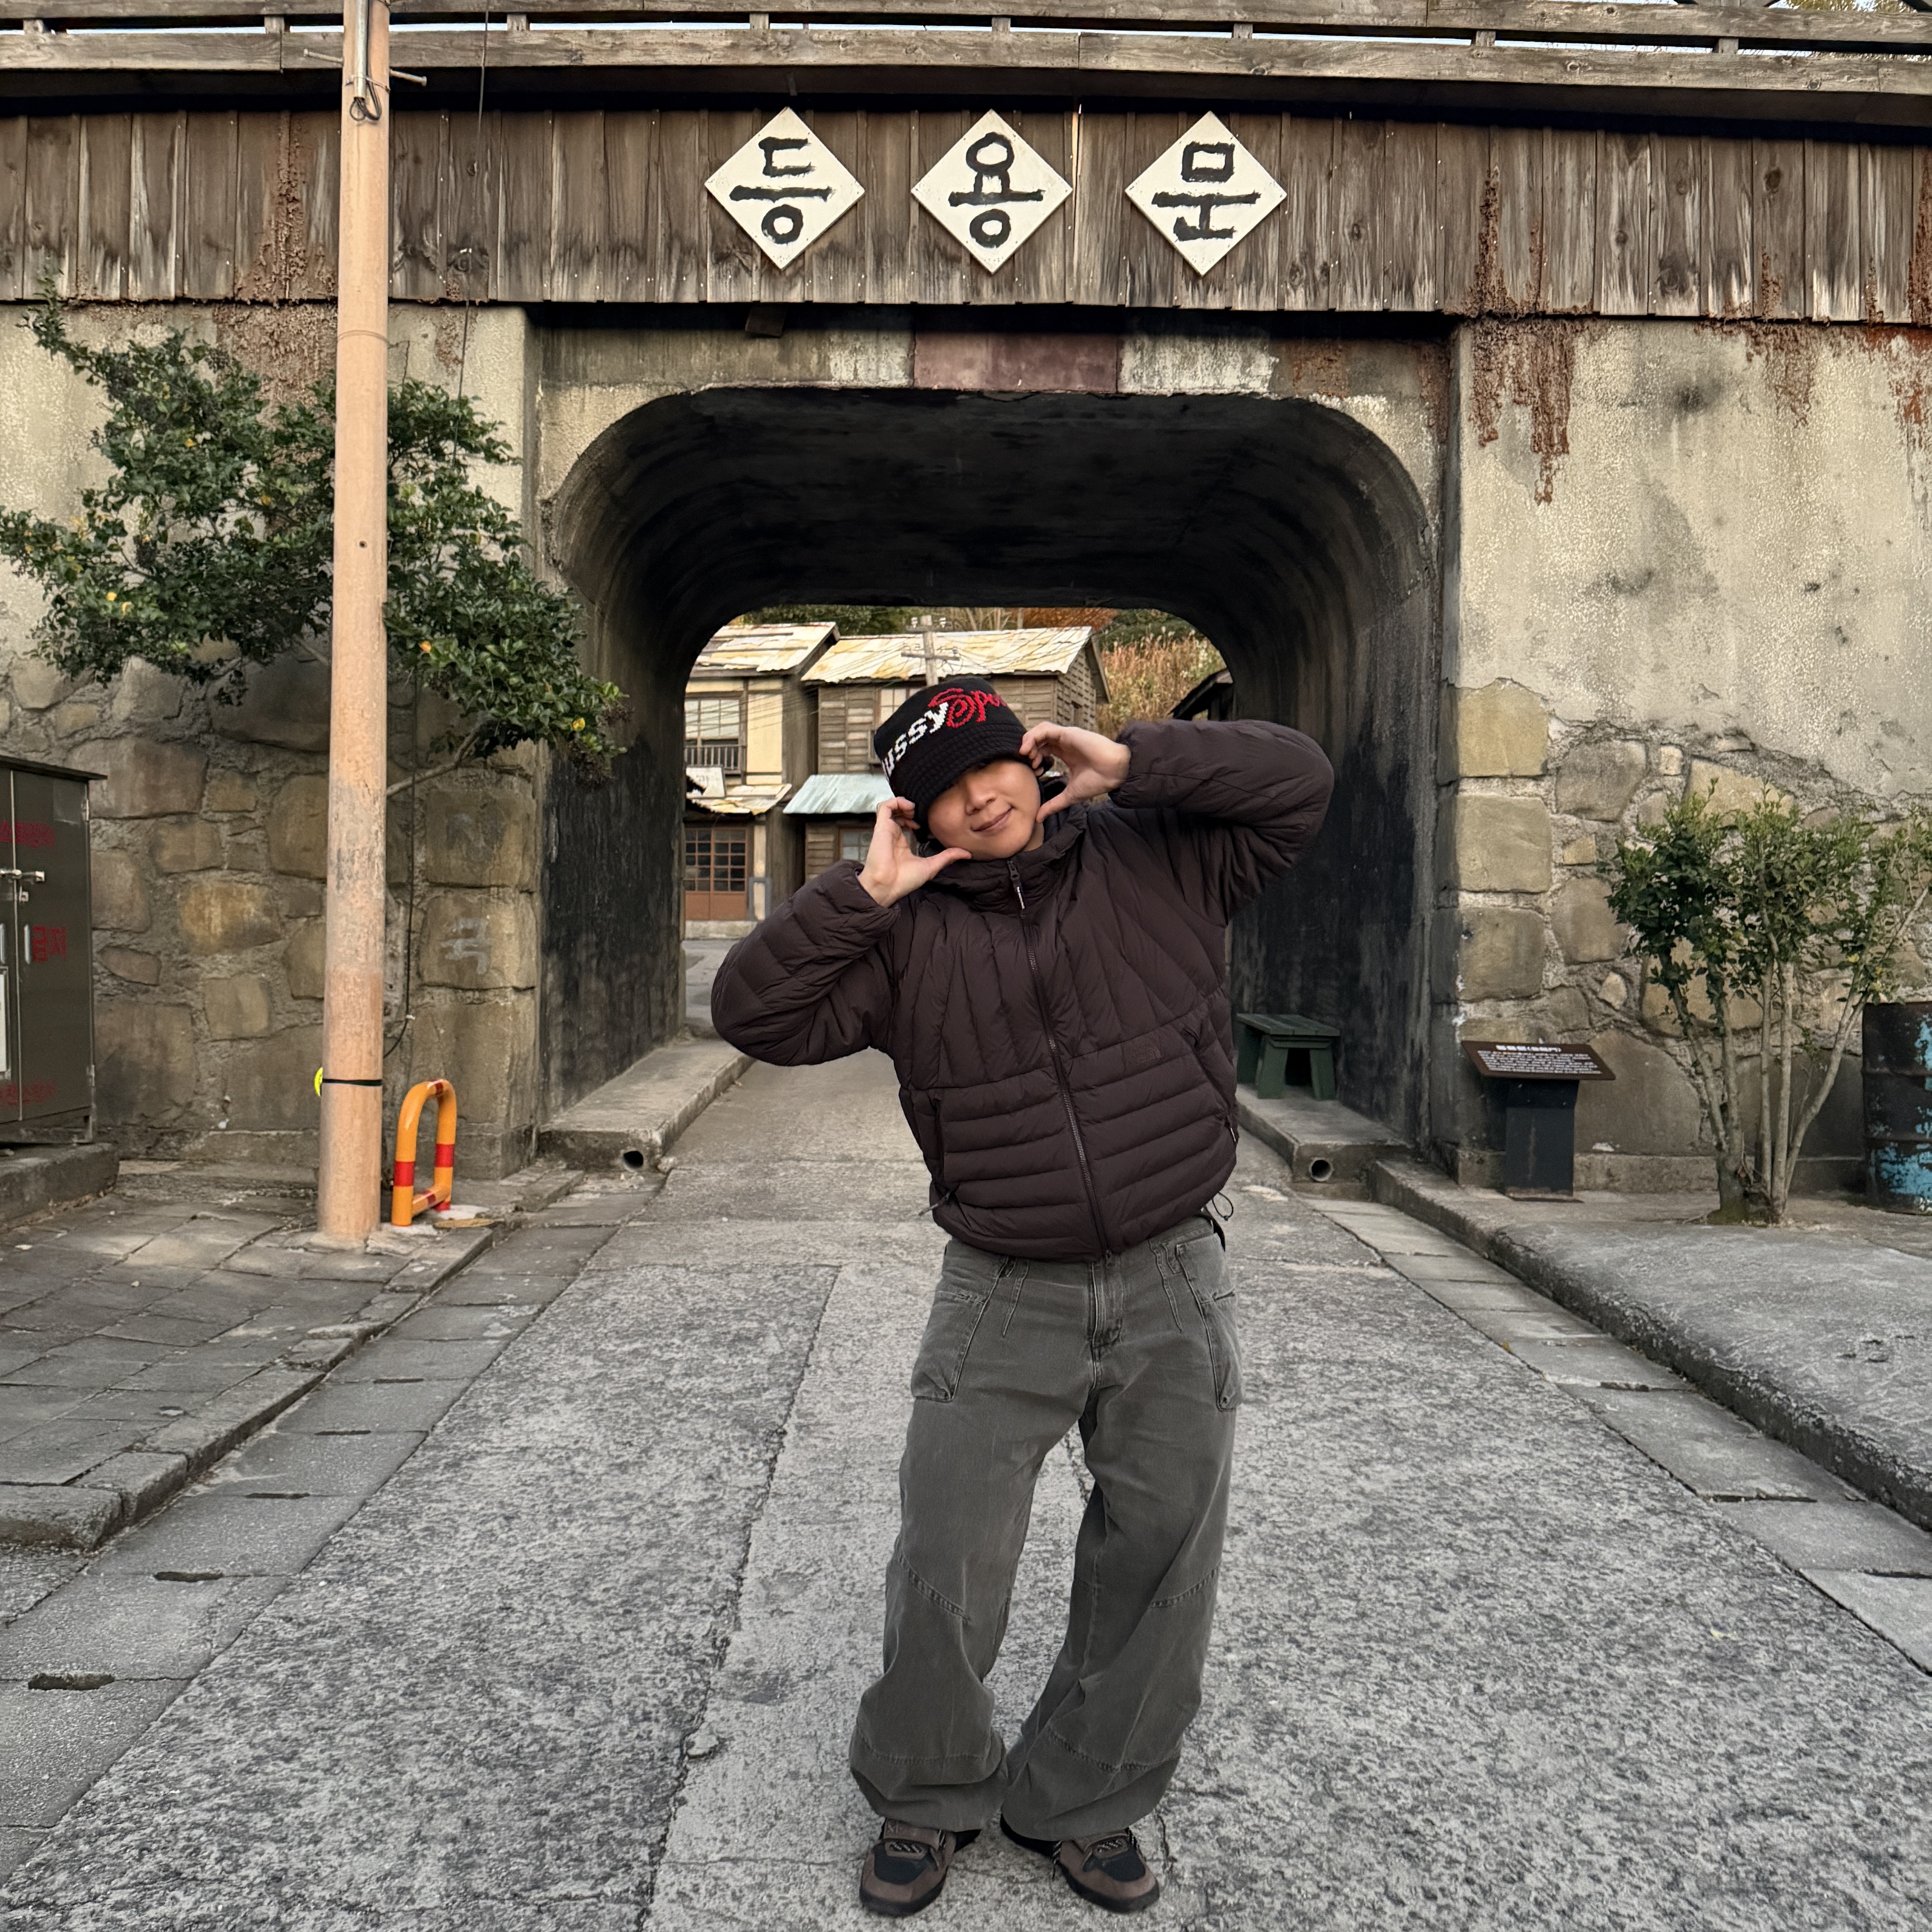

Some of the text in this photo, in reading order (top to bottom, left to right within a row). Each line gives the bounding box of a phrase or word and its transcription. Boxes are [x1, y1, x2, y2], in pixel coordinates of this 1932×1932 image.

[729, 132, 1261, 248] 등 용 문
[32, 925, 67, 962] 금지
